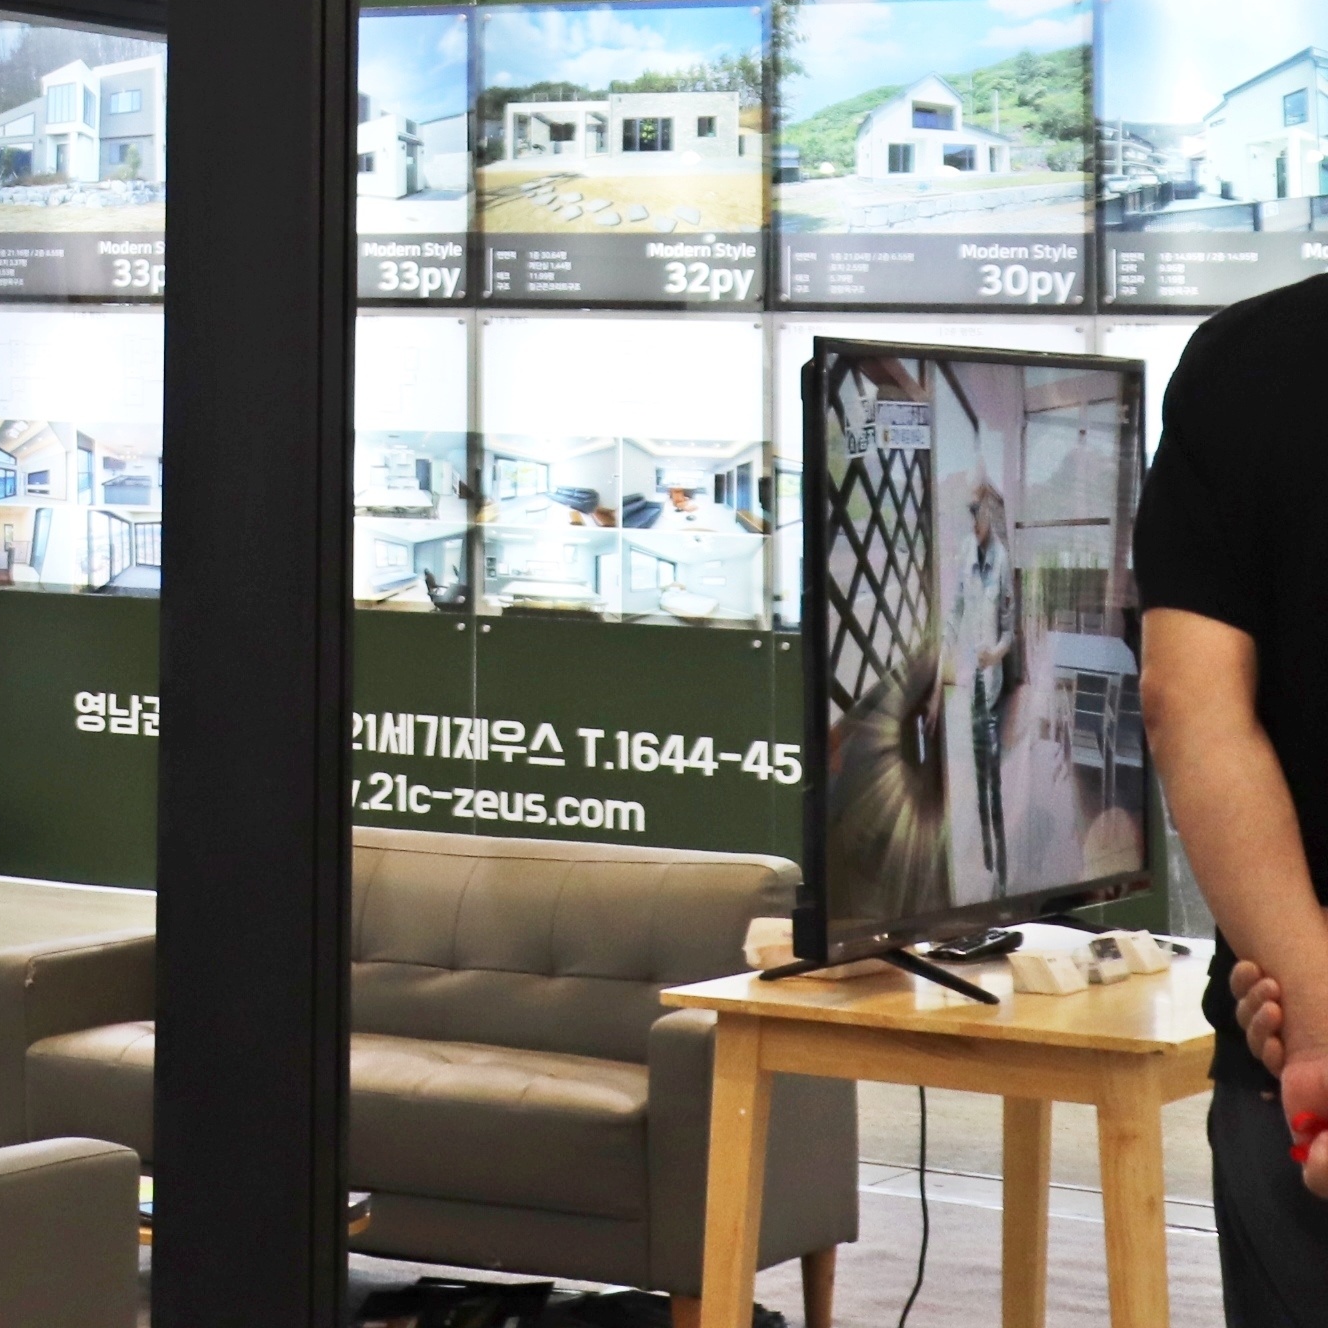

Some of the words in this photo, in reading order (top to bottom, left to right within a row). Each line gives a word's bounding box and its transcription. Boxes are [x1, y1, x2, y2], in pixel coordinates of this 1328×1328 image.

[99, 240, 152, 254] Modern
[363, 241, 421, 257] Modern
[424, 241, 462, 259] Style
[647, 242, 705, 258] Modern
[707, 242, 756, 260] Style
[961, 242, 1029, 259] Modern
[1033, 243, 1078, 263] Style
[378, 260, 461, 298] 33py
[664, 261, 754, 300] 32py
[980, 263, 1076, 304] 30py
